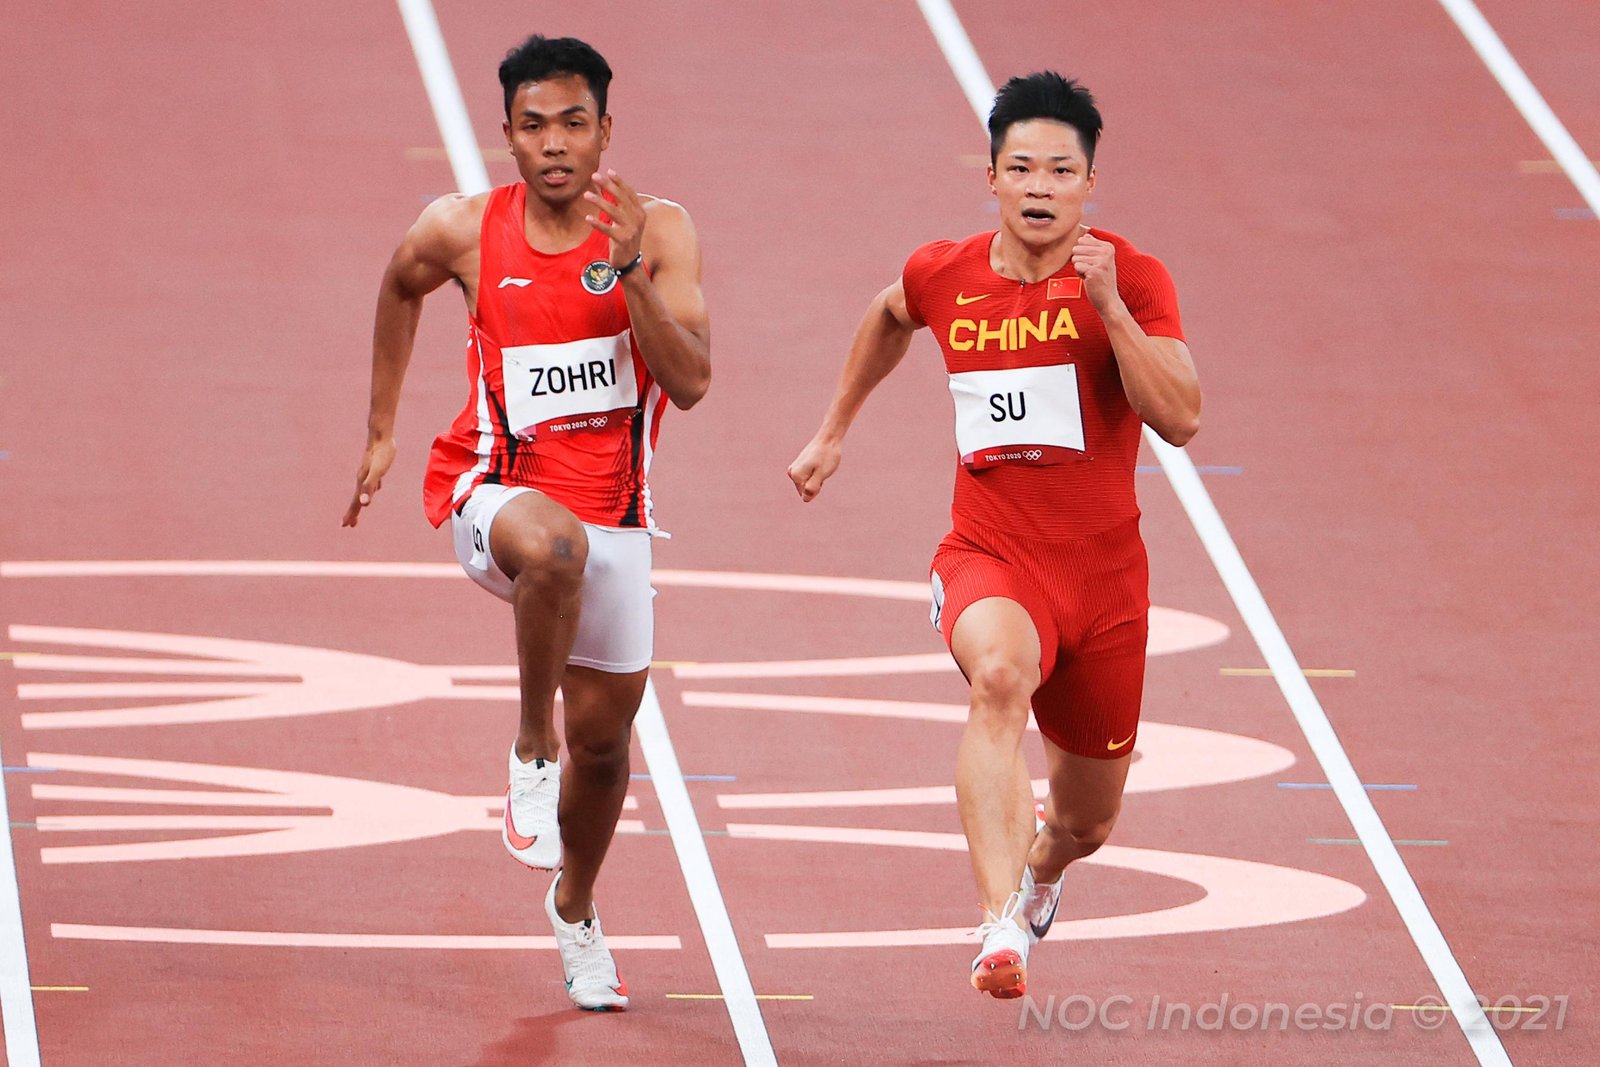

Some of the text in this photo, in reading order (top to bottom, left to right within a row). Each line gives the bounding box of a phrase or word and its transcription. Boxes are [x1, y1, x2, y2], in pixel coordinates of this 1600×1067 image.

[949, 307, 1080, 351] CHINA
[529, 358, 617, 397] ZOHRI
[989, 391, 1026, 423] SU
[549, 420, 588, 432] TOKYO 2020
[985, 454, 1006, 462] TOKYO
